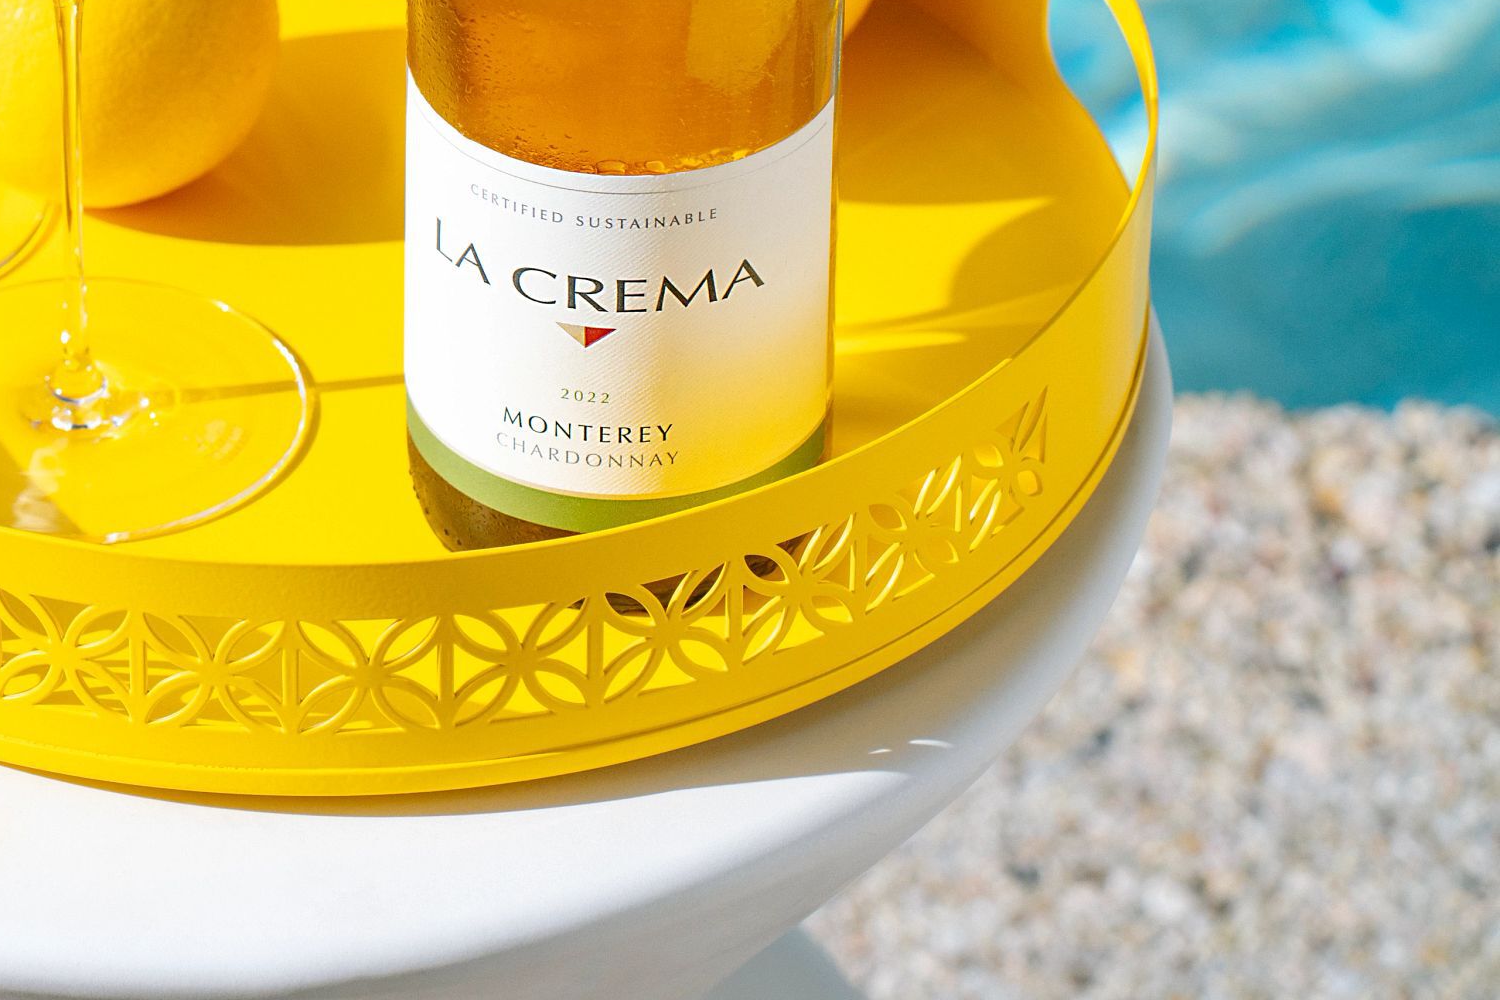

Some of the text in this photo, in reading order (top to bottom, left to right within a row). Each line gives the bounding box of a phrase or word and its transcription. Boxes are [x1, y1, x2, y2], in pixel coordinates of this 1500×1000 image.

[470, 183, 718, 229] CERTIFIED SUSTAINABLE
[436, 217, 765, 313] LA CREMA
[560, 387, 610, 404] 2022
[503, 406, 673, 444] MONTEREY
[496, 432, 680, 468] CHARDONNAY
